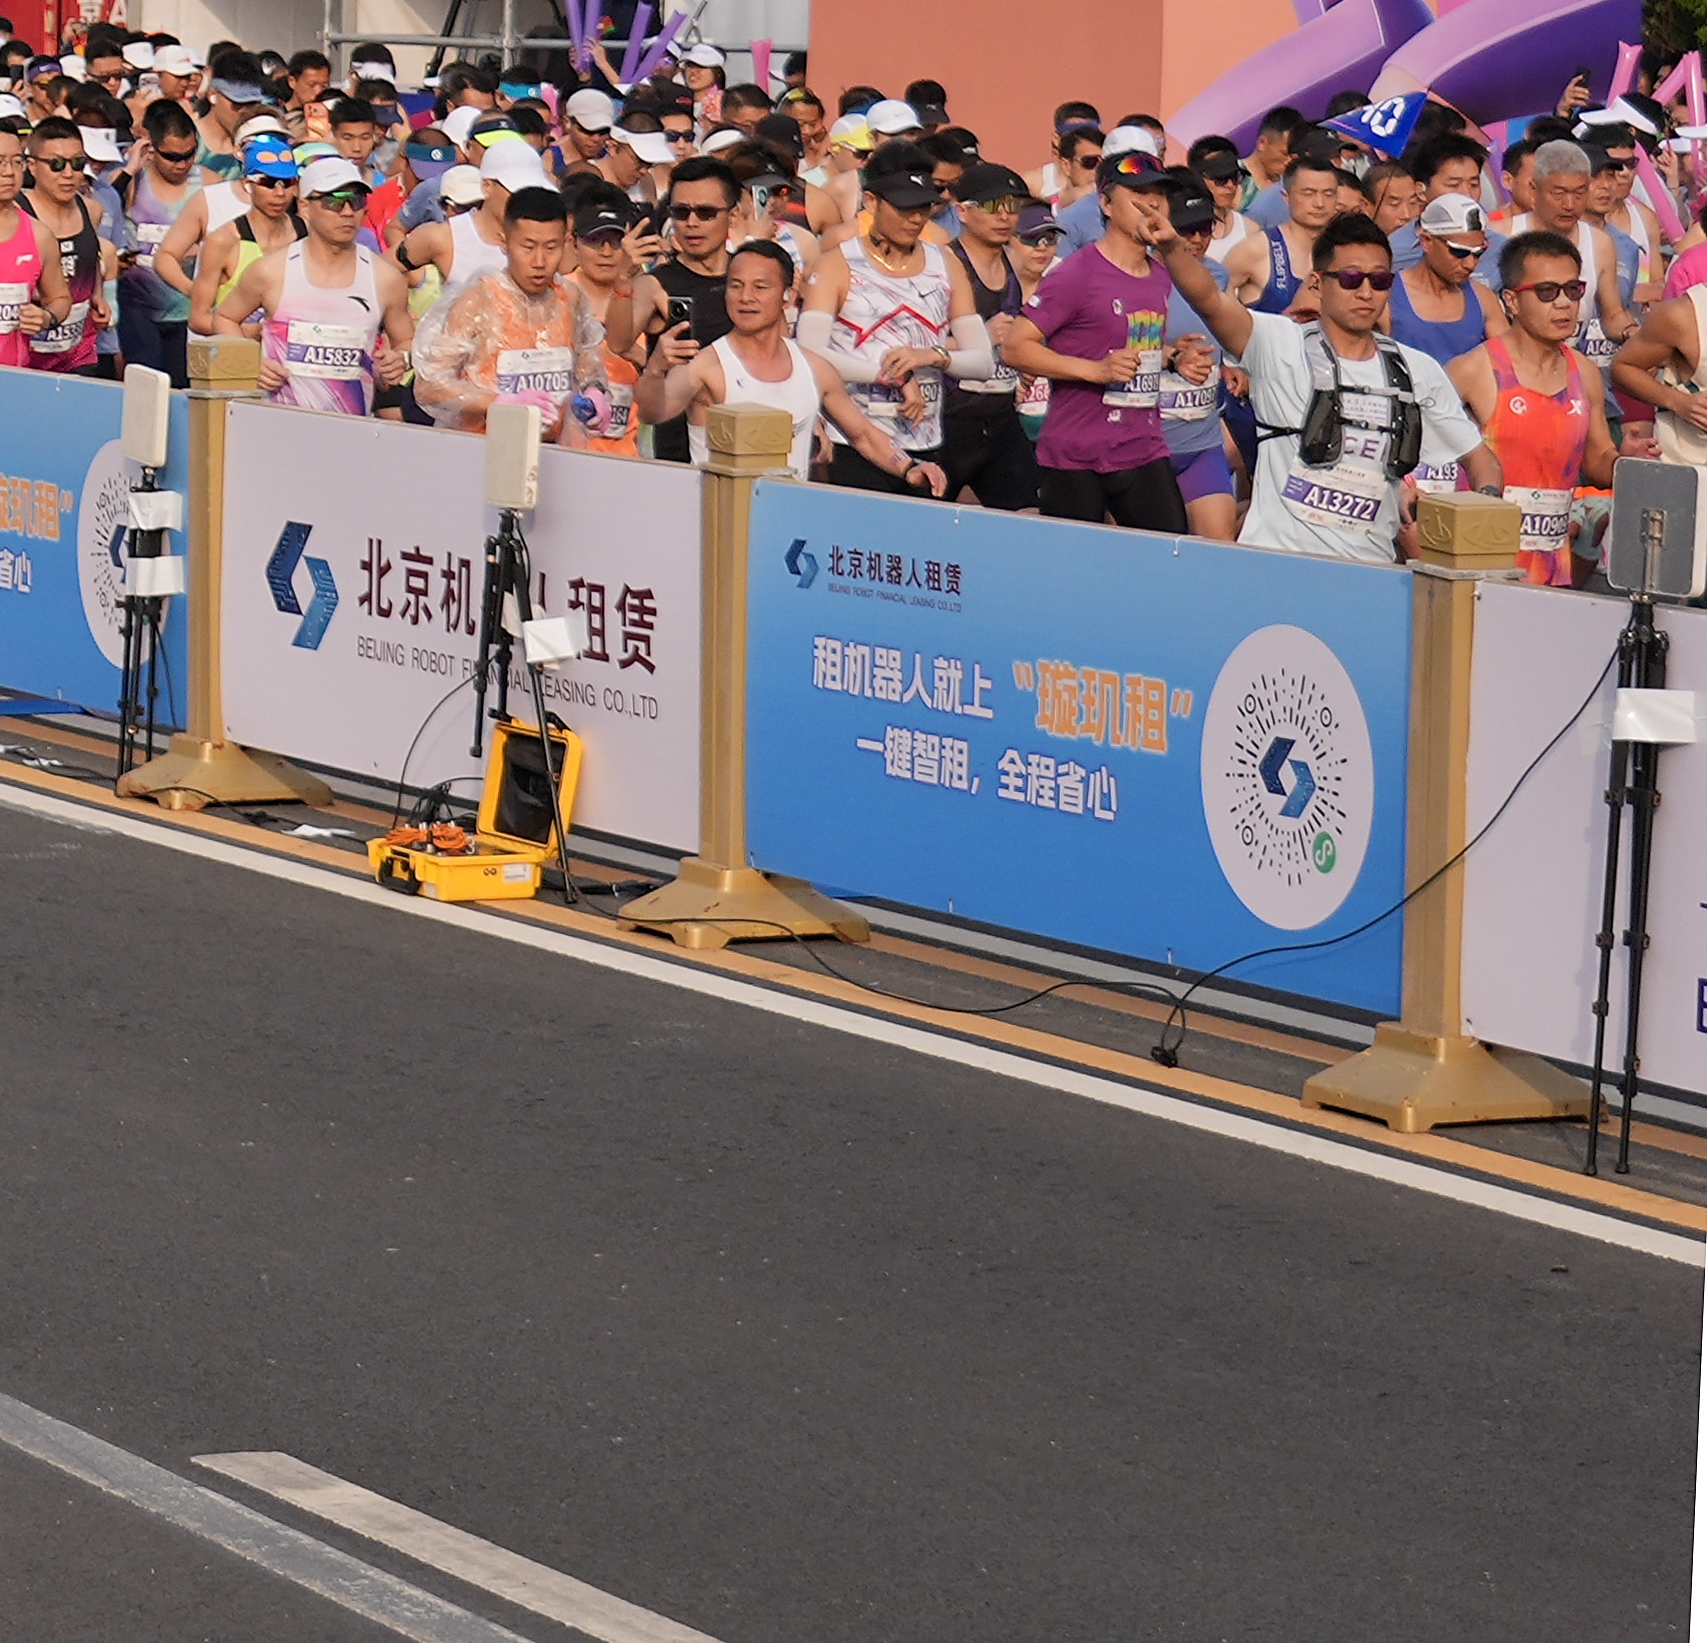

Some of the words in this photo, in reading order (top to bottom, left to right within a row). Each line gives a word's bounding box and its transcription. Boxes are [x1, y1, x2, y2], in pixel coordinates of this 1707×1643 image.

[1276, 239, 1289, 292] FLIPBELT
[304, 344, 362, 366] A15832
[516, 371, 570, 392] A10705
[1304, 488, 1376, 521] A13272
[828, 545, 963, 597] 北京机器人租赁
[358, 537, 658, 675] 北京机租赁
[357, 635, 405, 663] BEIJING
[412, 647, 455, 677] ROBOT
[462, 660, 530, 693] FIANIAL
[812, 635, 995, 720] 租机器人就上
